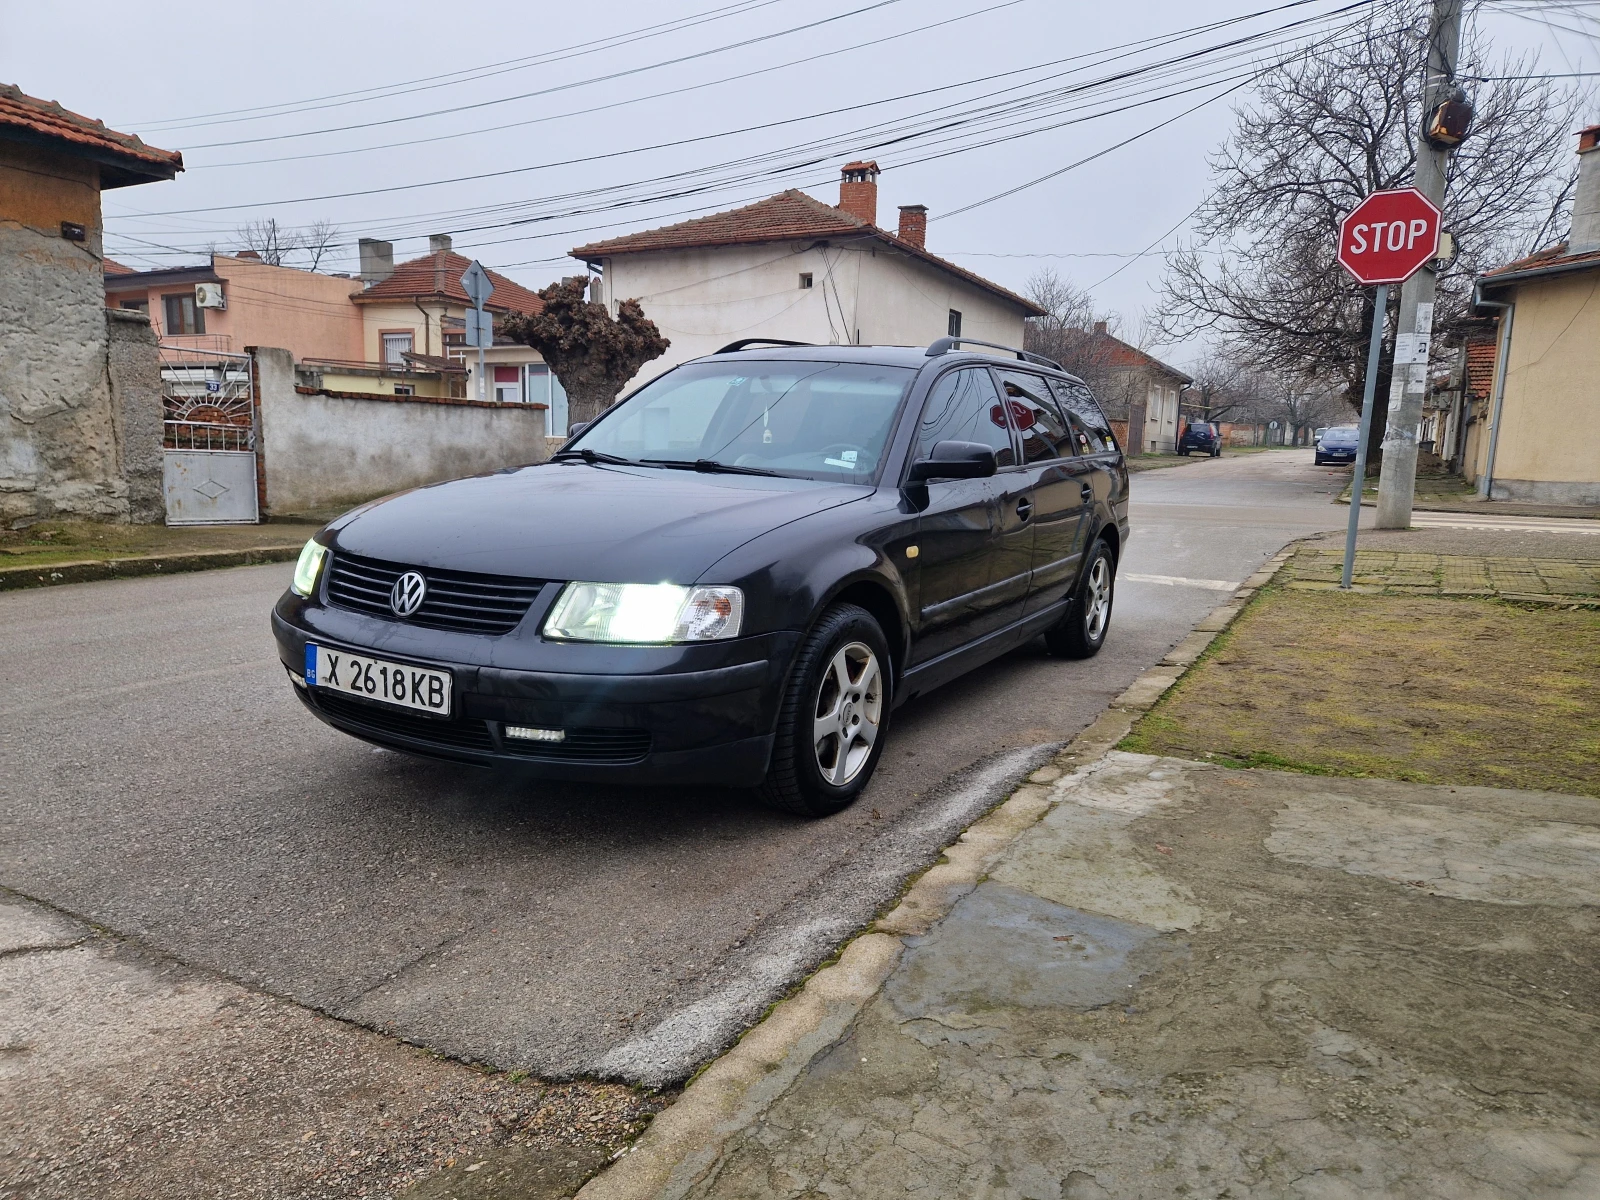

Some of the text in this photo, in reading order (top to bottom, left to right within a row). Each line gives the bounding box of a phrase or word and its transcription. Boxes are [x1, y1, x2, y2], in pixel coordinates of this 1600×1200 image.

[1350, 219, 1428, 254] STOP
[306, 668, 316, 679] BG
[327, 654, 340, 686] X
